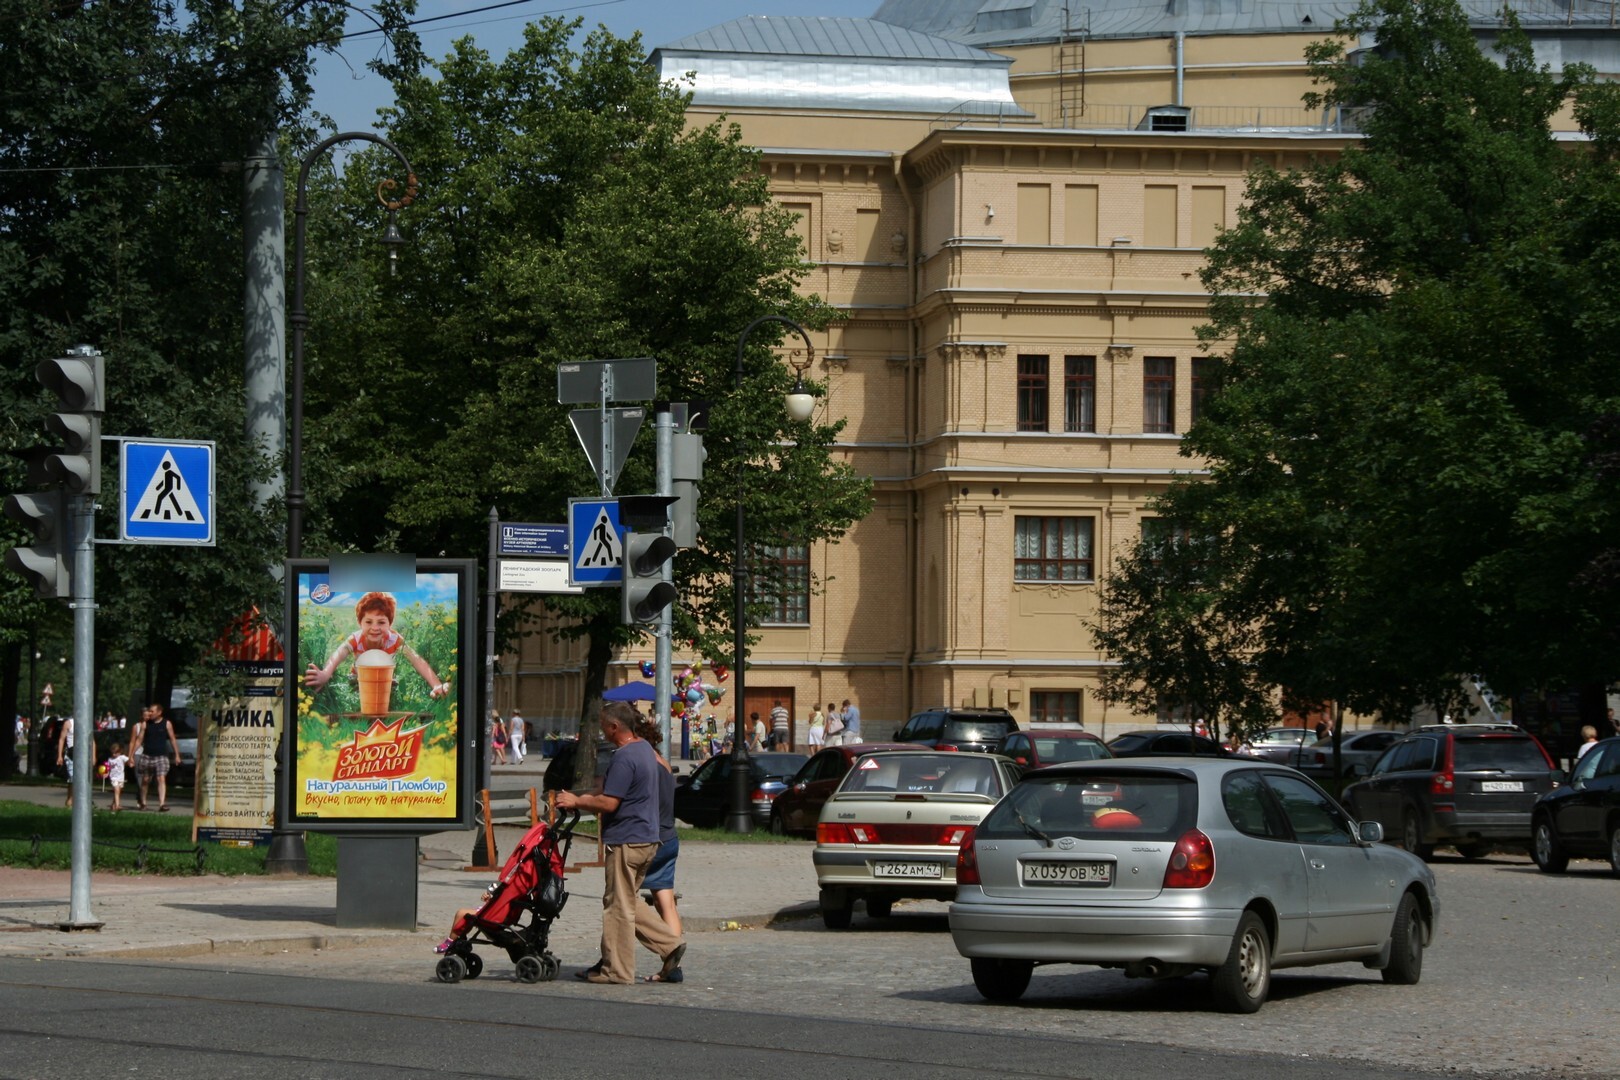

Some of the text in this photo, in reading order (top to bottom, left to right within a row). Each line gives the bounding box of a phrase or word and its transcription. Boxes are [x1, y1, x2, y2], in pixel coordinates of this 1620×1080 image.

[211, 705, 274, 728] ЧАЙКА
[337, 756, 412, 779] СТАНДАРТ
[308, 779, 446, 793] Натуральный Пломбир
[306, 793, 340, 808] Вкусно,
[374, 795, 386, 805] что
[206, 808, 270, 817] Йонаса ВАЙТКУСА
[926, 864, 938, 873] 47
[1091, 864, 1104, 876] 98
